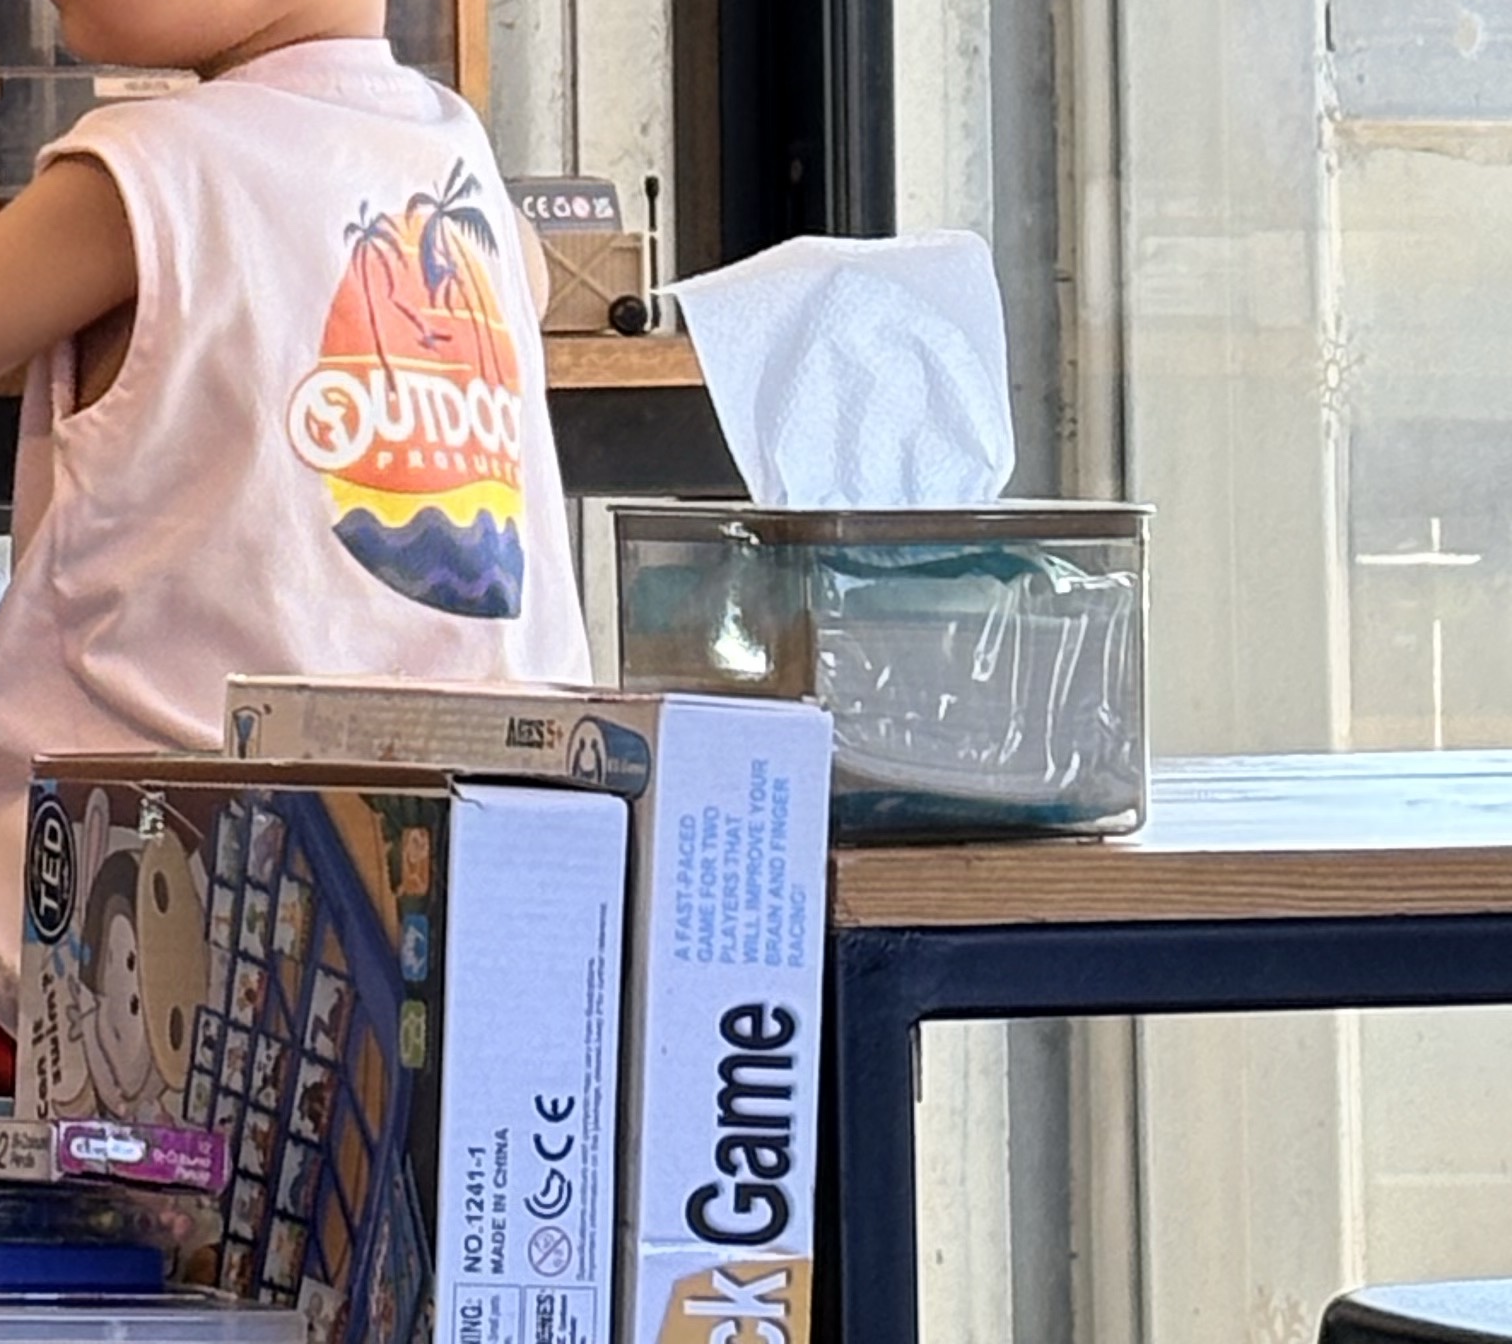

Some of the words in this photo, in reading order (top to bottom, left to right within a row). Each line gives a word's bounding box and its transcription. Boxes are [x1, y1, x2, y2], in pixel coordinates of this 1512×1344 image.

[749, 759, 768, 815] YOUR
[770, 778, 788, 851] FINGER
[702, 806, 719, 851] TWO
[724, 815, 741, 866] THAT
[40, 818, 62, 916] TED
[675, 815, 695, 941] FAST-PACED
[700, 858, 717, 898] FOR
[746, 821, 764, 910] IMPROVE
[768, 858, 785, 899] AND
[697, 904, 715, 962] GAME
[720, 872, 739, 964] PLAYERS
[743, 918, 760, 964] WILL
[765, 905, 782, 966] BRAIN
[674, 948, 690, 961] A
[684, 1004, 796, 1246] Game
[493, 1128, 509, 1188] CHINA
[463, 1146, 486, 1273] NO.1241-1
[492, 1194, 507, 1212] IN
[492, 1218, 507, 1274] MADE
